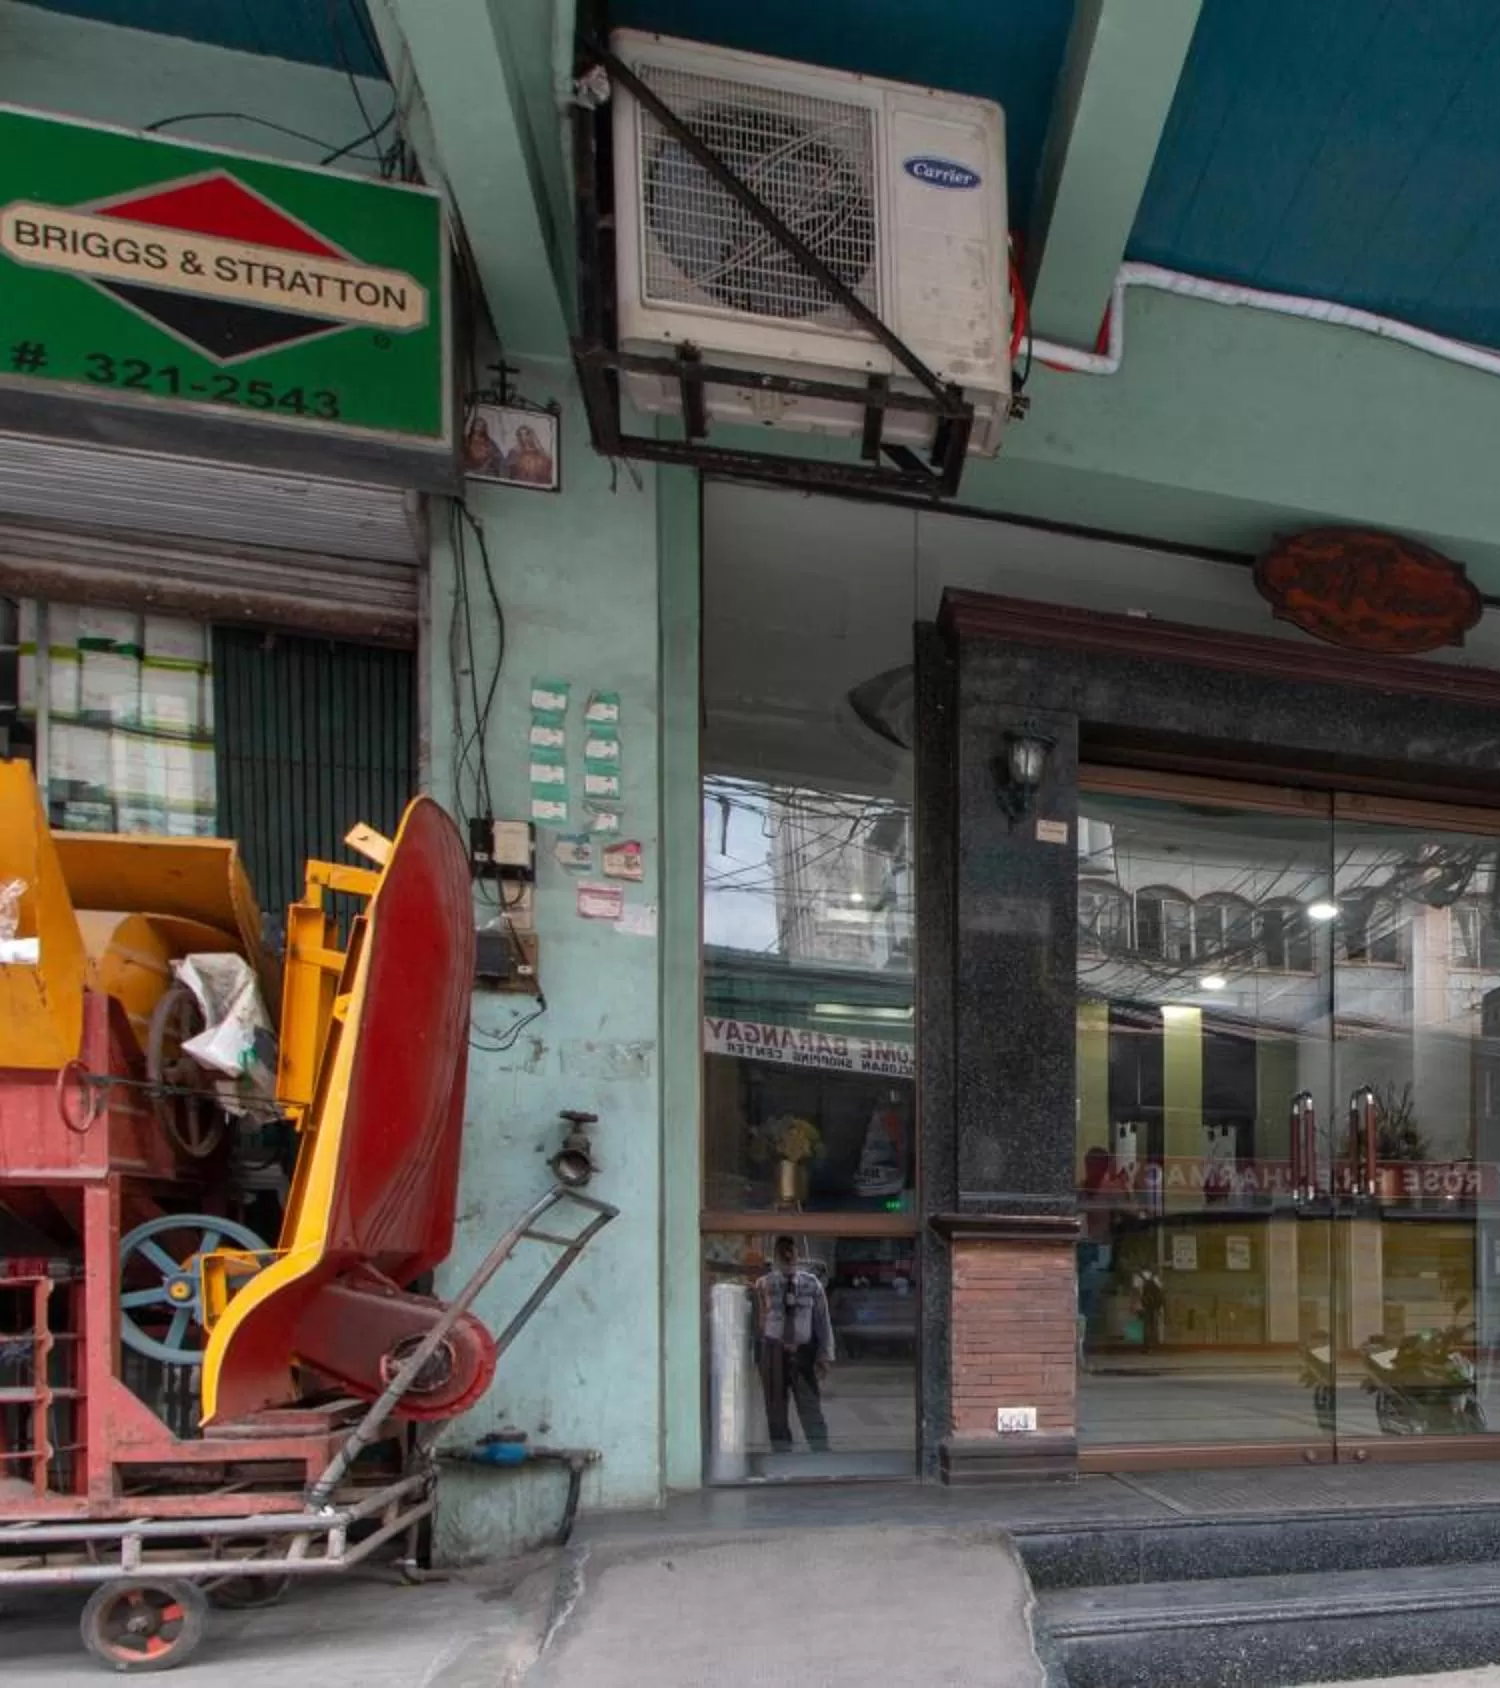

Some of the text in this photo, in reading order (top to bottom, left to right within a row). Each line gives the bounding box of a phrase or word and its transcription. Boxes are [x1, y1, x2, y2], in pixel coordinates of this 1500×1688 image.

[912, 163, 973, 185] Carrier
[14, 219, 408, 311] BRIGGS & STRATTON
[11, 340, 341, 420] # 321-2543
